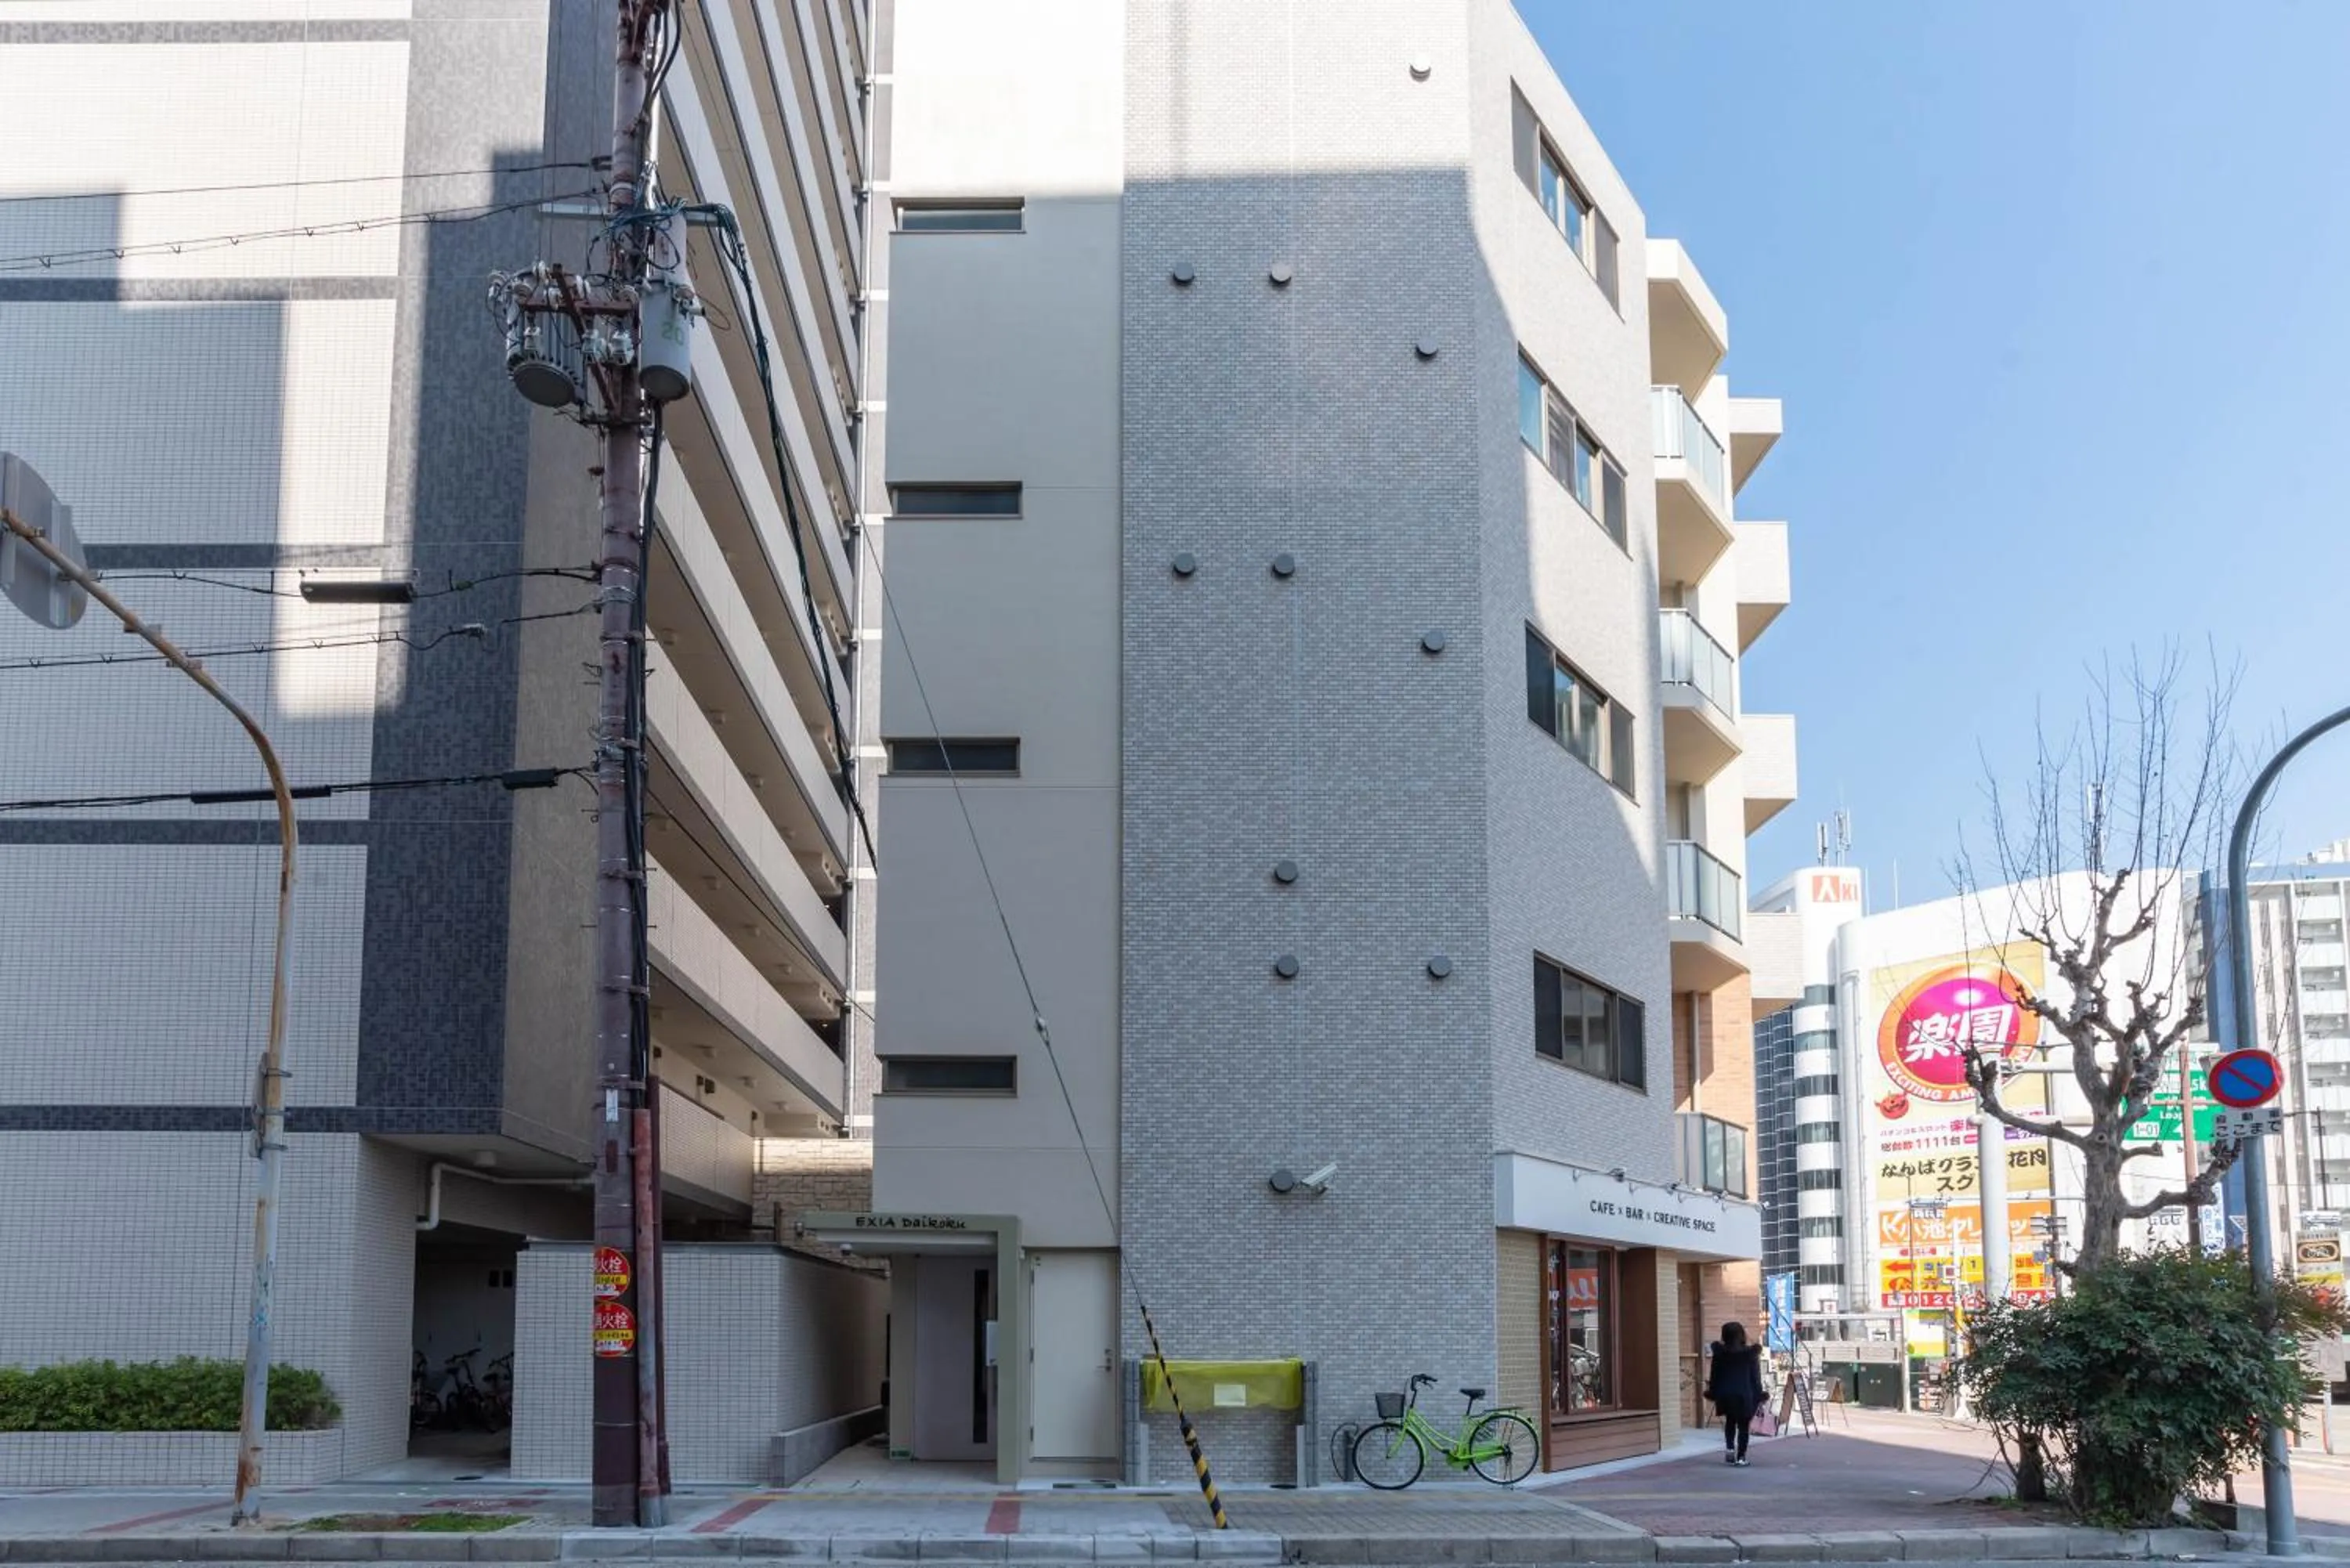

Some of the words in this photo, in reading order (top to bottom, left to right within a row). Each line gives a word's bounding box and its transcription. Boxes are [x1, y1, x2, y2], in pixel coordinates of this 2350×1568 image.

[1904, 1004, 2013, 1063] 楽園
[1885, 1061, 1942, 1100] EXCITING
[2216, 1120, 2281, 1137] ここまで
[855, 1216, 895, 1227] EXIA
[1589, 1200, 1615, 1216] CAFE
[1625, 1206, 1643, 1220] BAR
[1654, 1212, 1690, 1230] CREATIVE
[1693, 1219, 1716, 1232] SPACE
